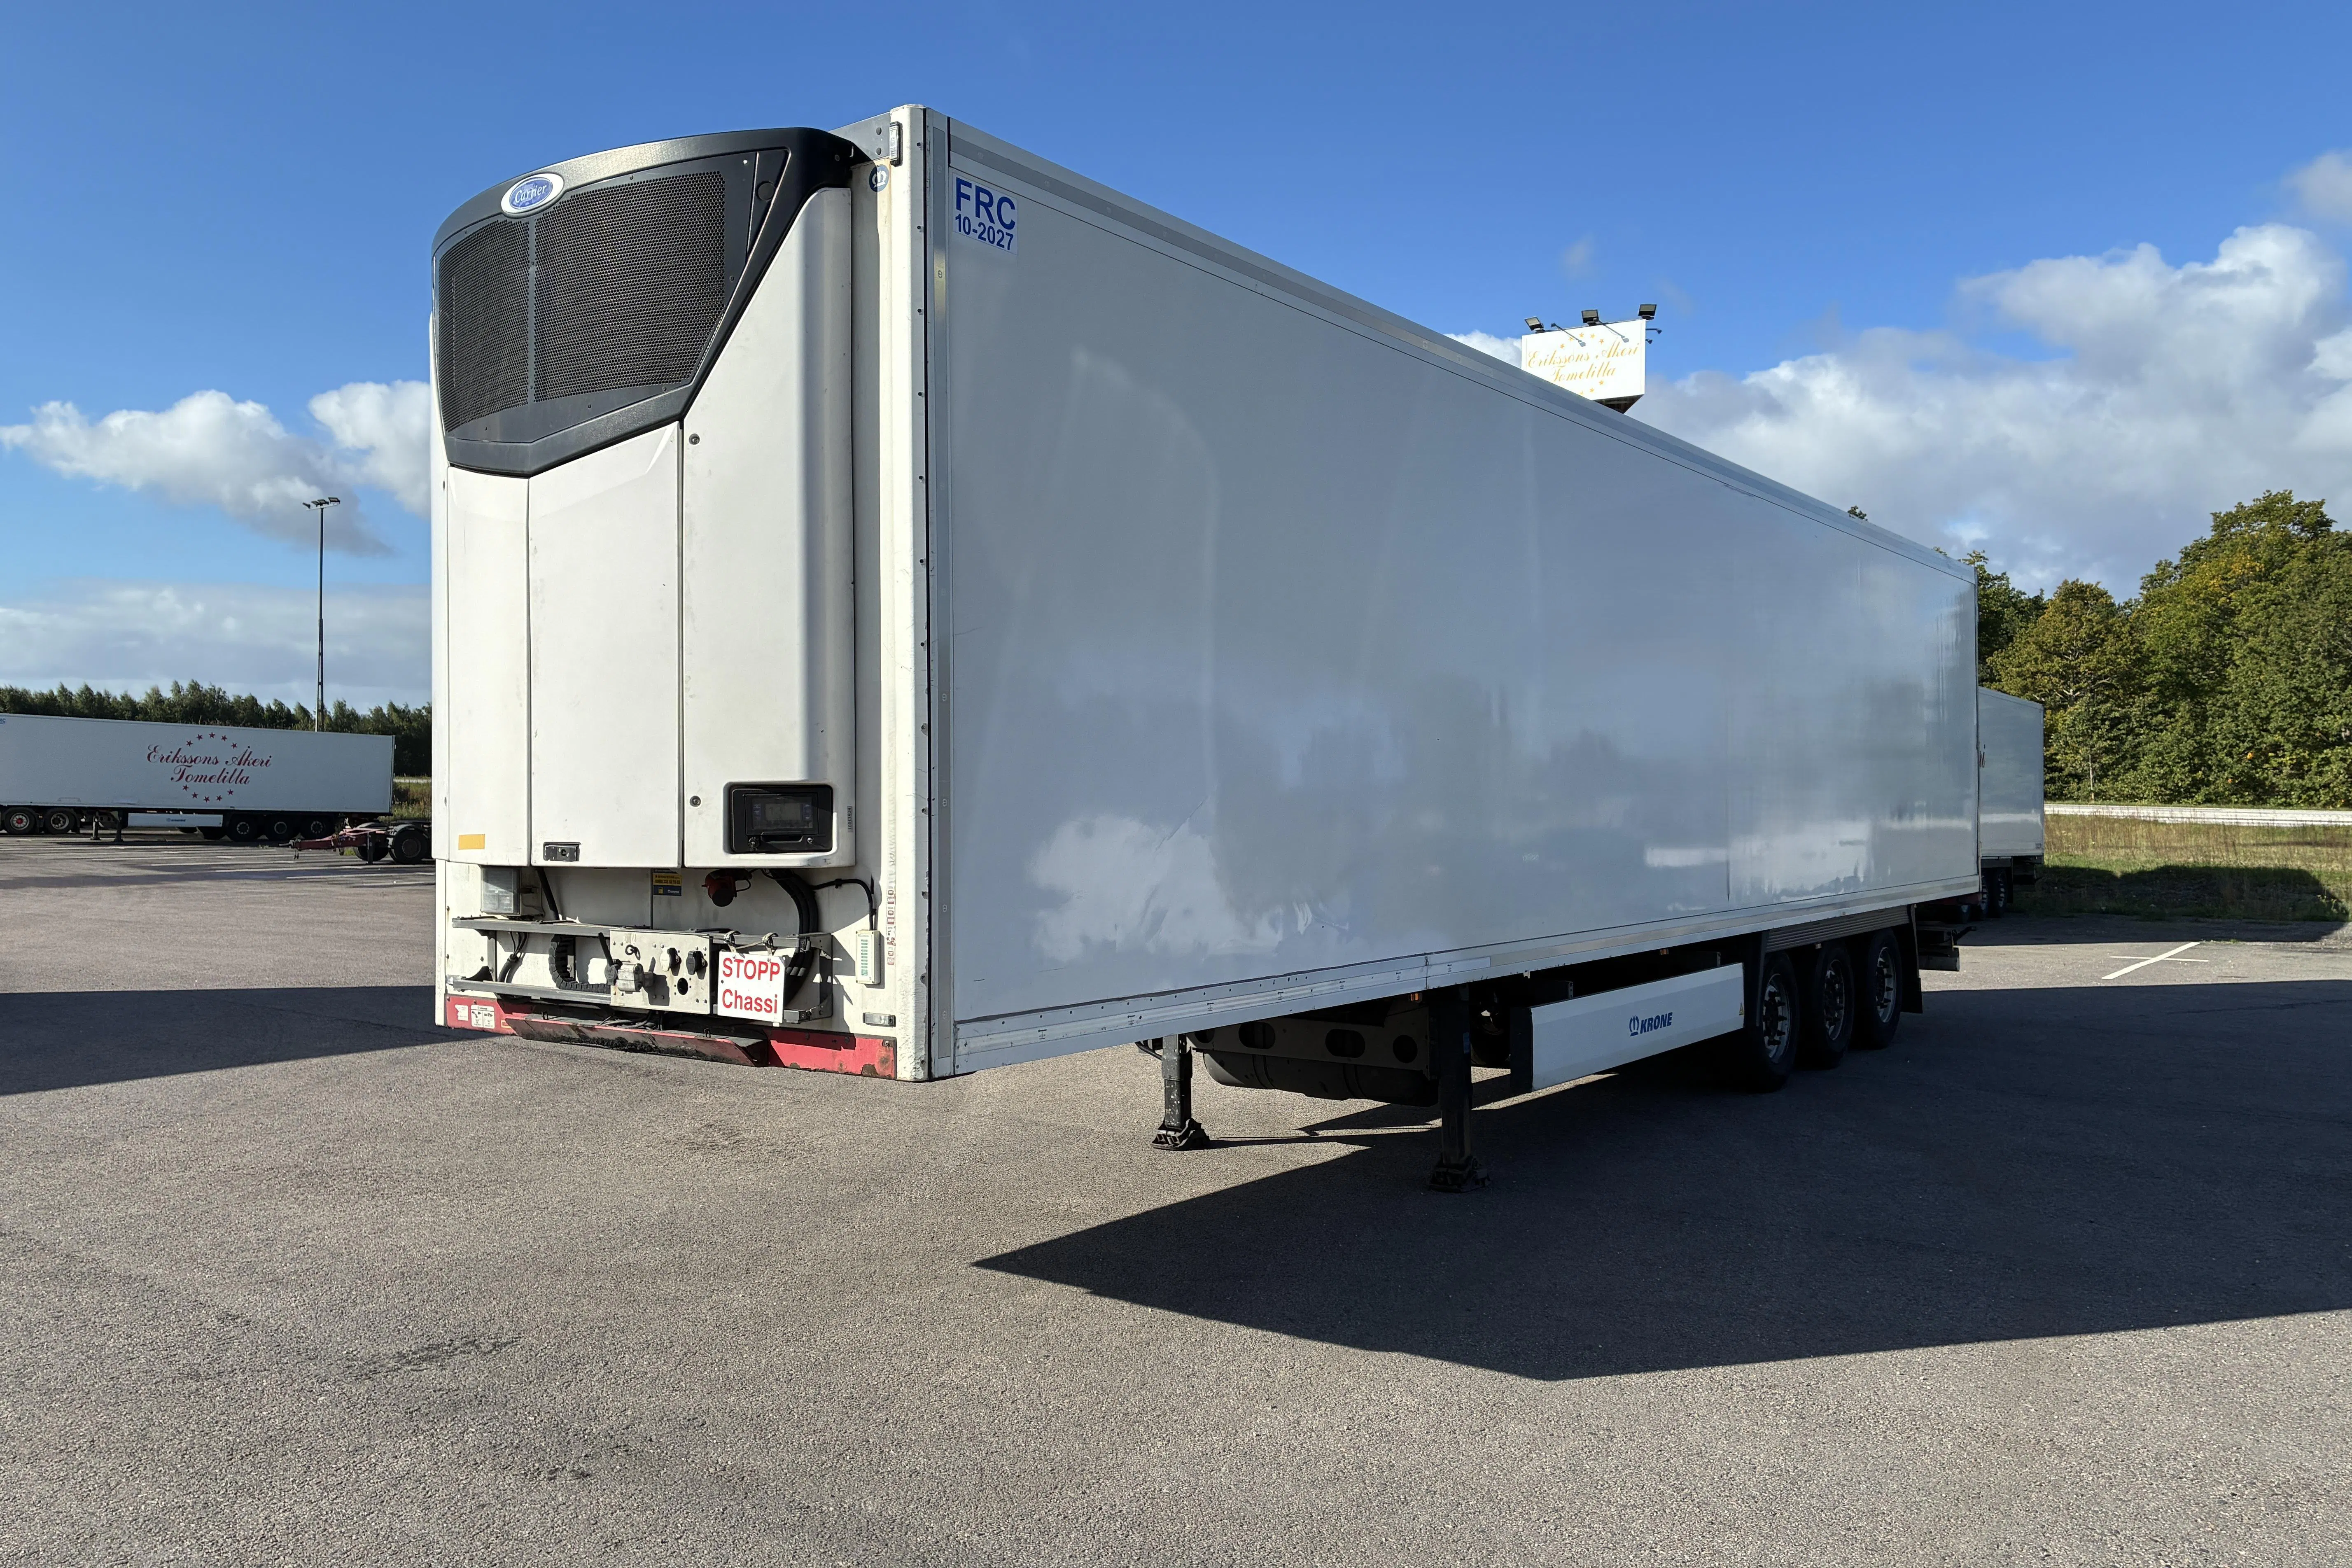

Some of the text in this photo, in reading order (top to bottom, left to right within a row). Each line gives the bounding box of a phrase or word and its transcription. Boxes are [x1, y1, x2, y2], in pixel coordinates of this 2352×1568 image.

[515, 184, 547, 203] Carrier
[956, 177, 1015, 230] FRC
[955, 213, 1014, 251] 10-2027
[147, 744, 272, 768] Erikssons Åkeri
[170, 764, 250, 785] Tomelilla
[722, 957, 780, 981] STOPP
[722, 989, 778, 1014] Chassi
[1640, 1012, 1673, 1034] KRONE
